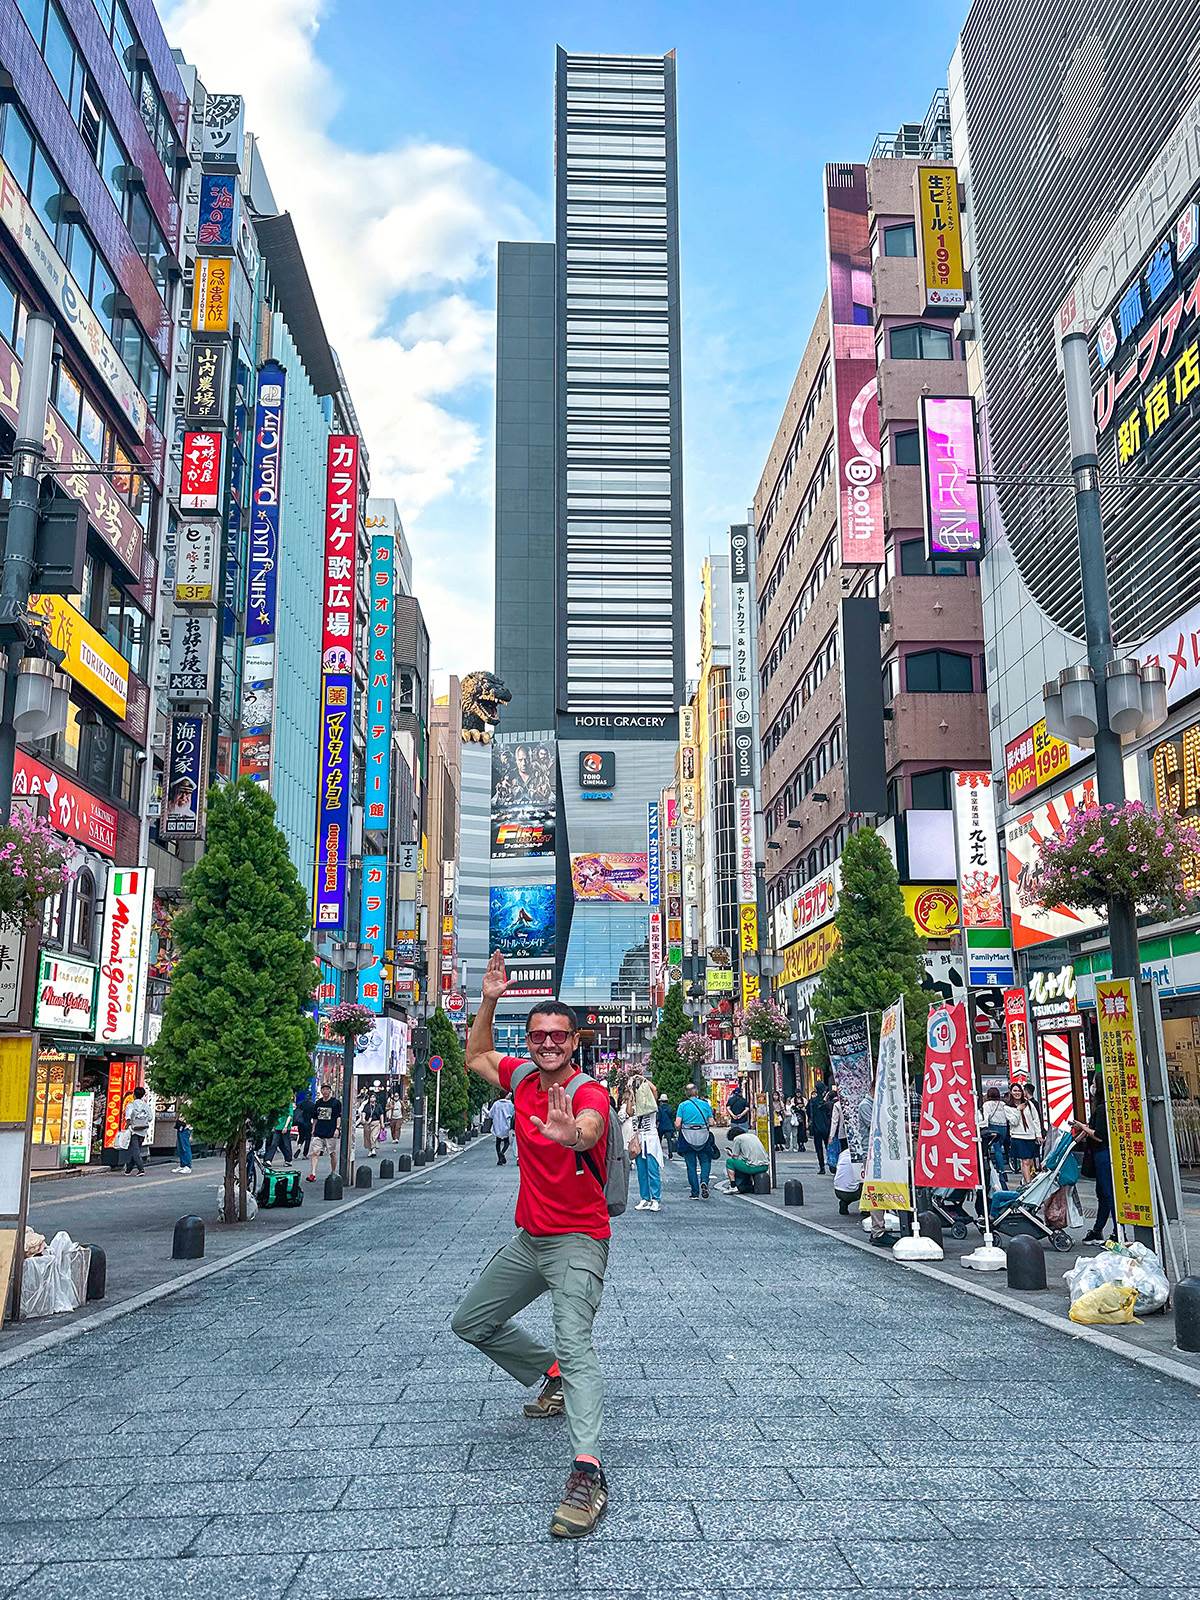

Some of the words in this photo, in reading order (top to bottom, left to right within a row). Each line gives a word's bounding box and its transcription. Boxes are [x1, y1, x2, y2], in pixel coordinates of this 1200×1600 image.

[206, 98, 235, 149] ダーツ
[199, 186, 233, 243] 海の家
[928, 175, 947, 231] 生ビール
[209, 268, 225, 323] 鳥貴族
[193, 348, 216, 406] 山内農場
[198, 406, 210, 415] 5F
[1118, 340, 1200, 467] 新宿店
[184, 449, 202, 493] さかい
[200, 445, 216, 482] 焼肉屋
[190, 496, 207, 507] 4F
[844, 456, 877, 540] Booth
[326, 442, 355, 638] カラオケ歌広場
[732, 535, 749, 576] Booth
[250, 520, 274, 610] SHINJUKU
[185, 586, 203, 598] 3F
[736, 586, 746, 634] ネットカフェ
[179, 618, 202, 673] お好み焼
[82, 643, 123, 694] TORIKIZOKU
[171, 675, 206, 689] 大阪家
[737, 650, 748, 683] カプセル
[330, 689, 345, 704] 薬
[325, 711, 347, 767] マツモト
[575, 716, 612, 727] HOTEL
[614, 716, 666, 727] GRACERY
[175, 722, 197, 774] 海の家
[737, 735, 753, 777] Booth
[1037, 743, 1069, 779] 199円
[88, 820, 114, 848] SAKAI
[327, 824, 341, 848] Shop
[649, 806, 658, 835] 747
[740, 798, 751, 836] カラオケ
[326, 850, 339, 871] Free
[968, 829, 989, 866] 九十九
[325, 873, 338, 893] Tax
[649, 838, 658, 902] カラオケランド
[798, 880, 828, 926] カラオケ
[107, 896, 130, 966] Miami
[500, 938, 545, 949] リトル・マーメイド
[510, 969, 553, 981] MARUHAN
[970, 952, 1011, 964] FamilyMart
[986, 972, 999, 985] 酒
[1028, 965, 1078, 1005] 九十九
[598, 1015, 621, 1024] TOHO
[1032, 1002, 1070, 1017] TSUKUMO
[919, 1061, 948, 1180] ひとり
[945, 1062, 974, 1182] スタジオ
